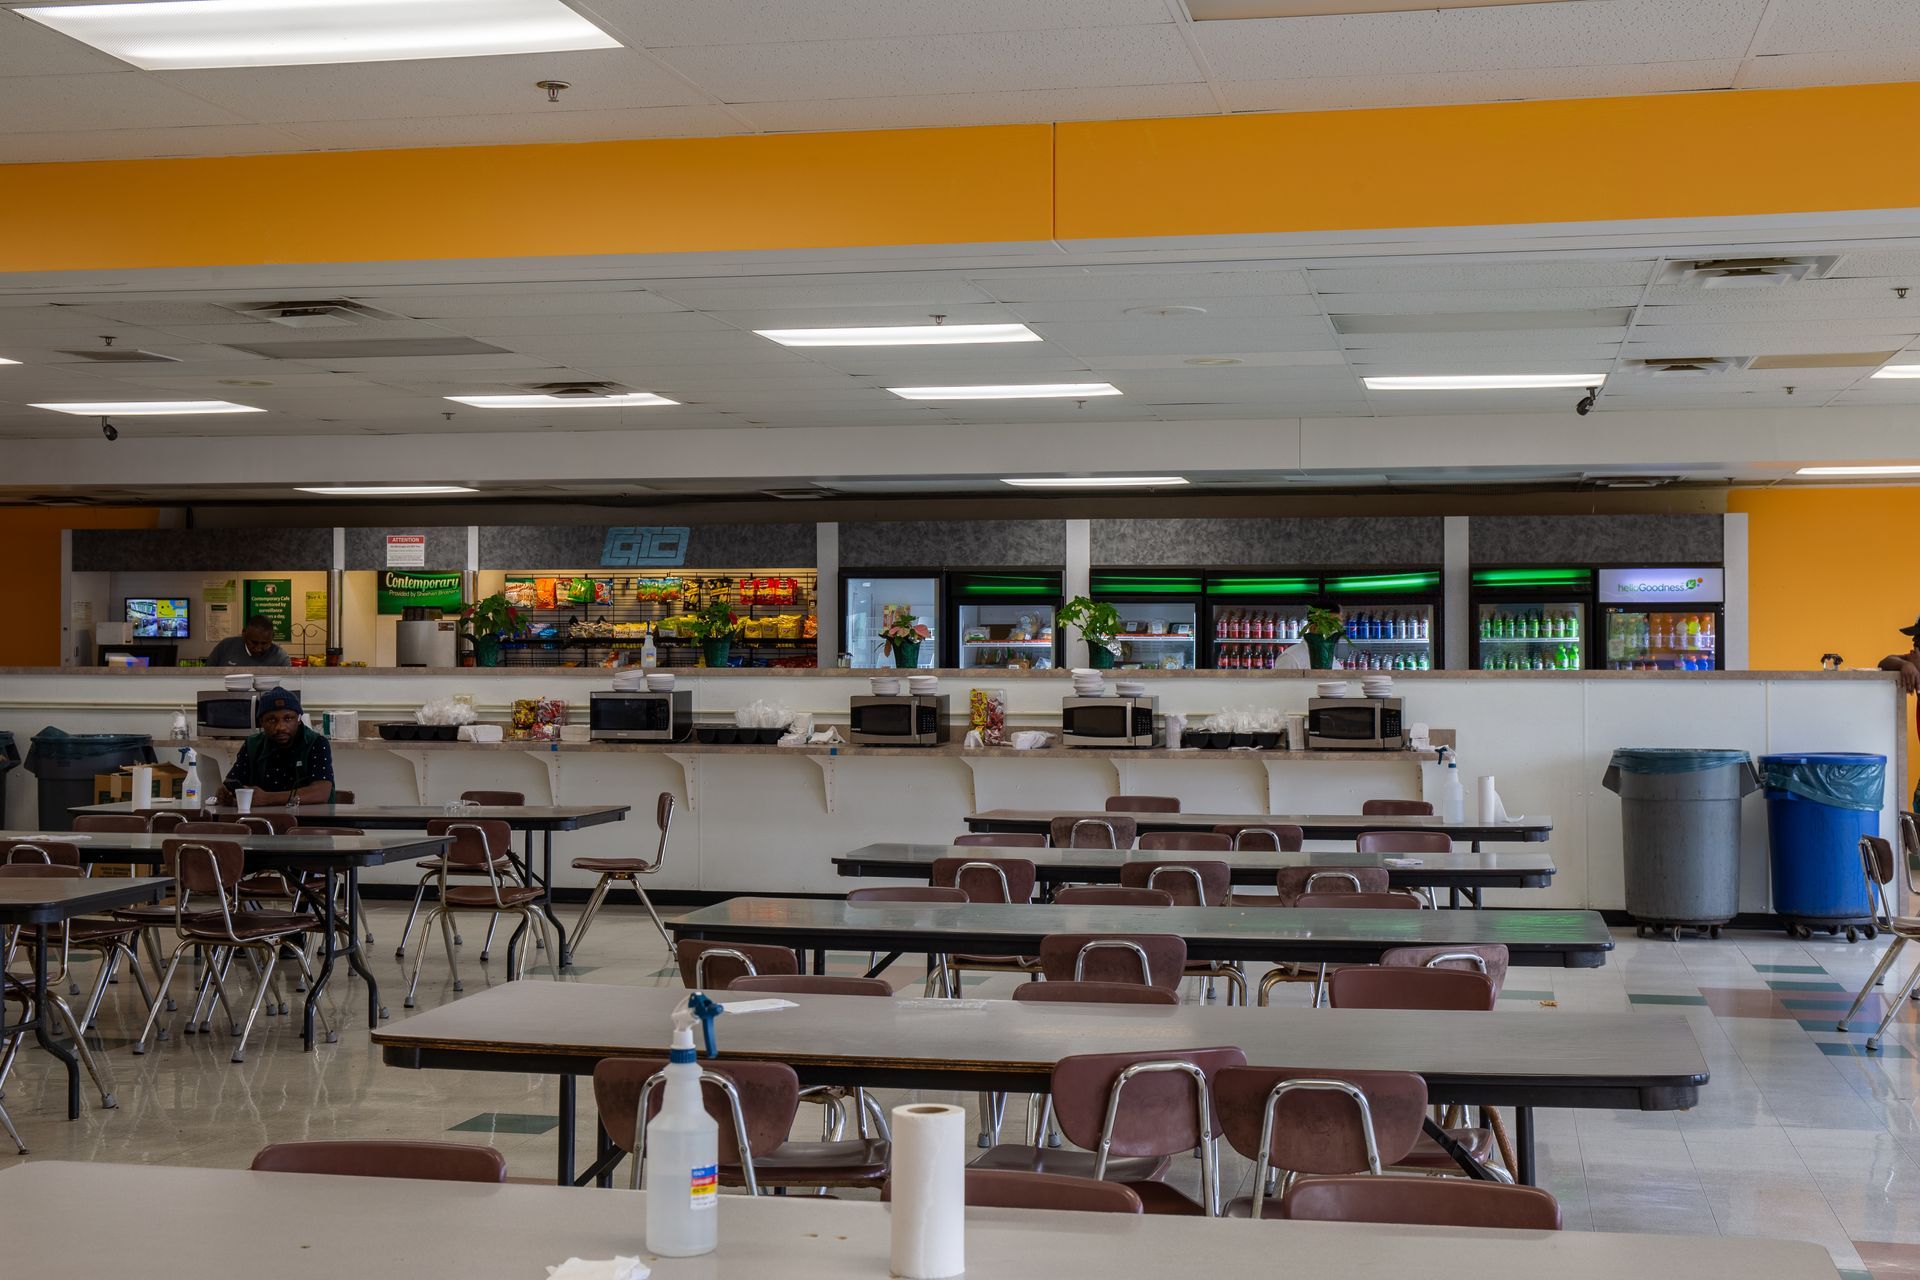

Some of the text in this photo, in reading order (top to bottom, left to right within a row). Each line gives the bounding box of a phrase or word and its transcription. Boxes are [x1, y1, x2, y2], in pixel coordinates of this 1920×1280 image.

[386, 572, 459, 592] Contemporary
[389, 589, 410, 597] Provided
[410, 590, 416, 598] by
